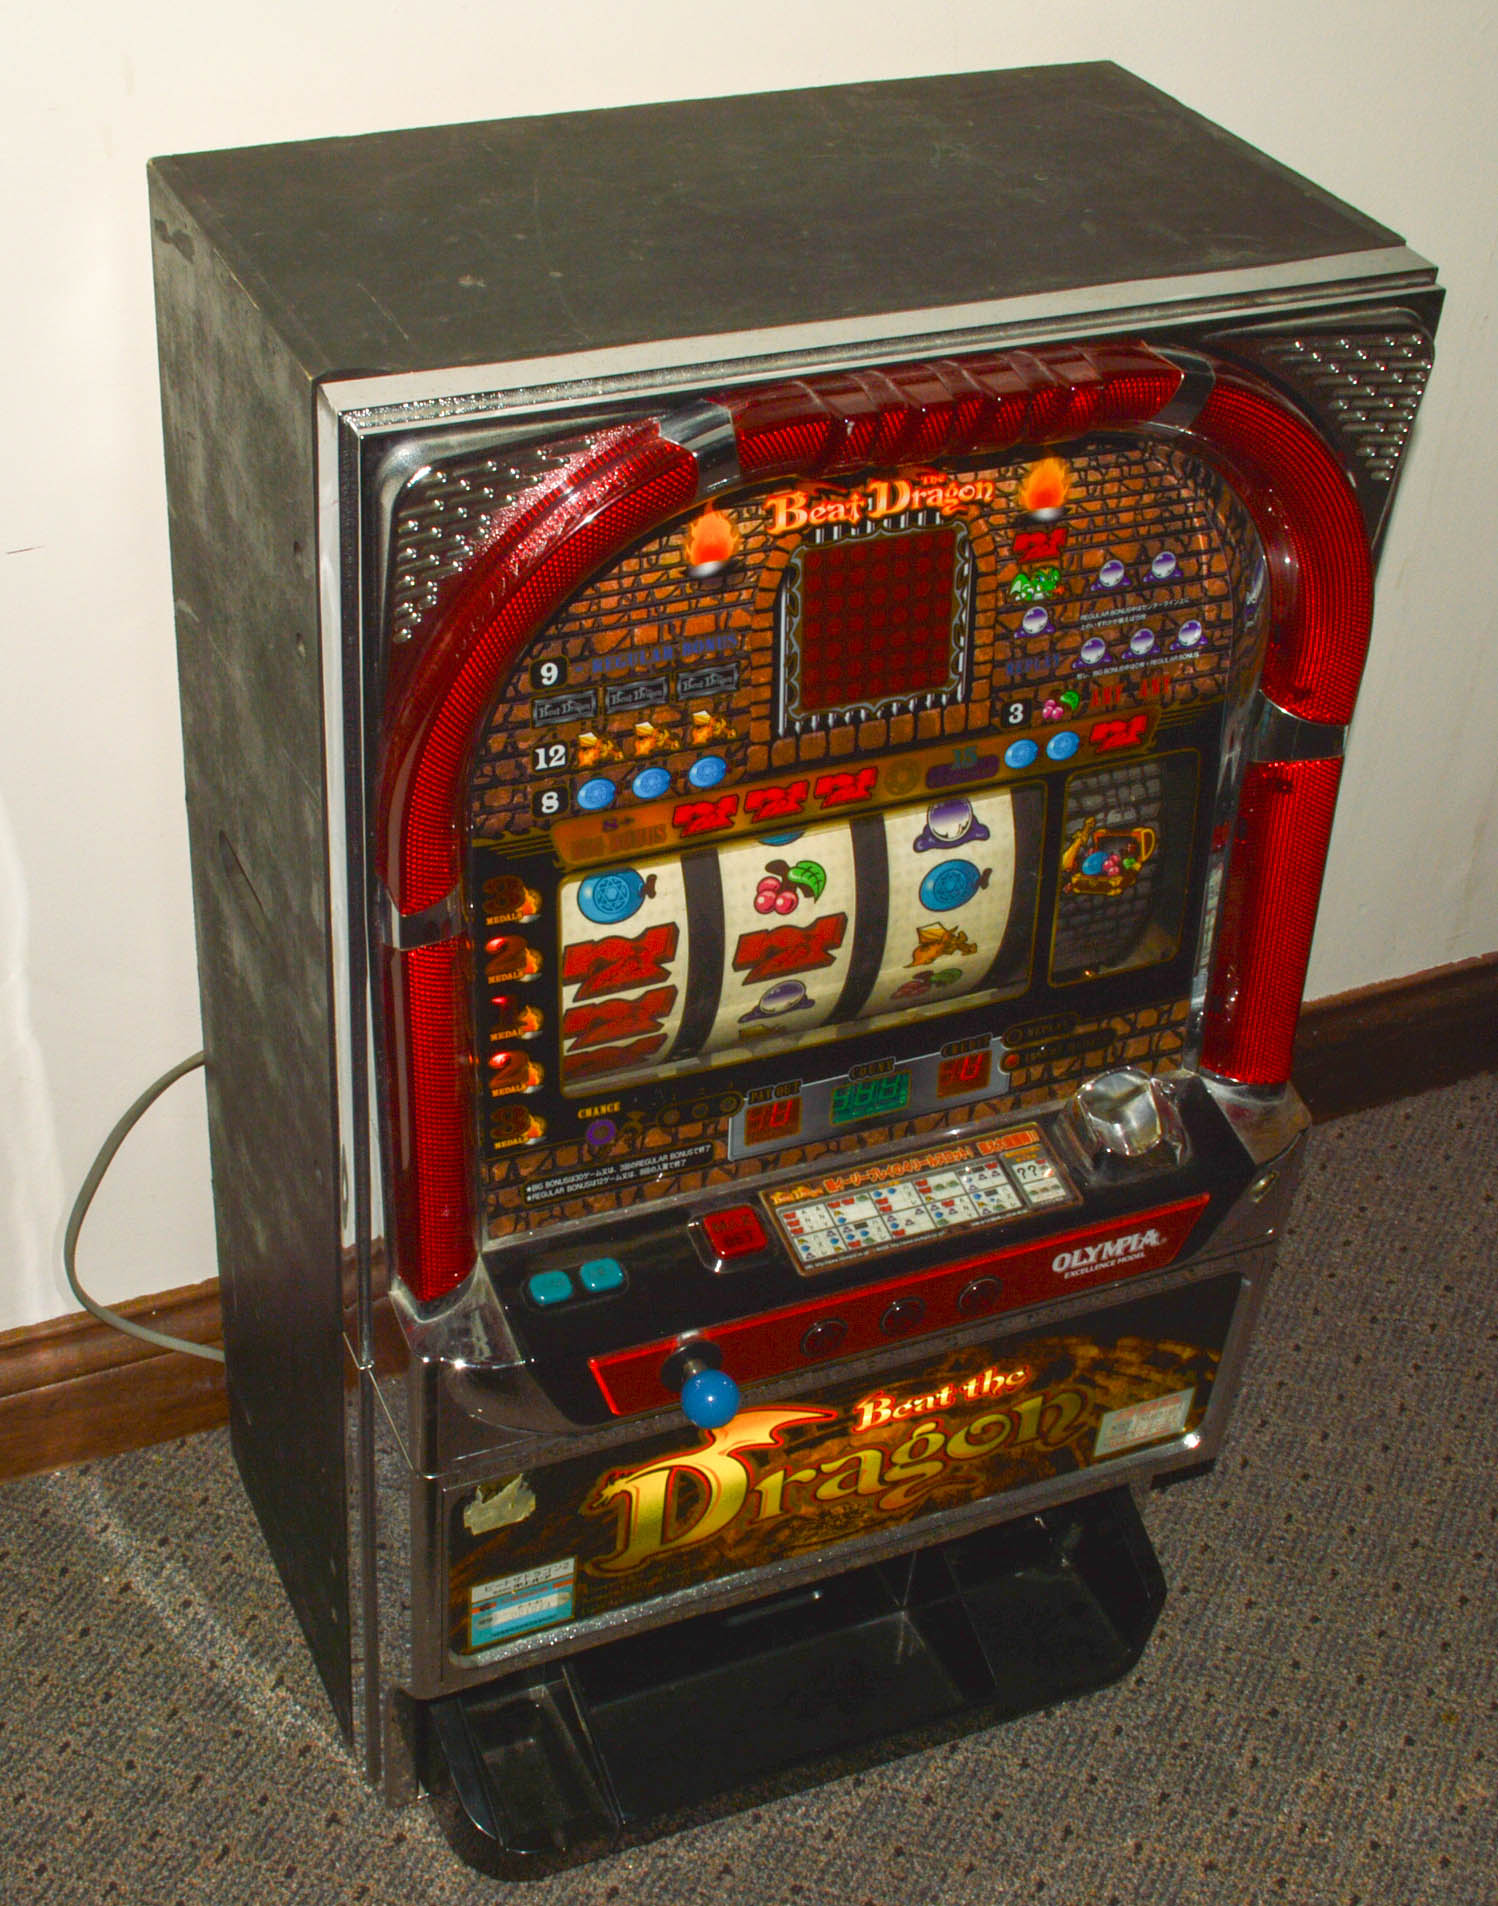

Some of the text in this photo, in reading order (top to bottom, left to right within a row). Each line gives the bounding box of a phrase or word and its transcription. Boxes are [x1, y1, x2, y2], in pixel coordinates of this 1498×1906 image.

[763, 478, 995, 535] Beat Dragon
[540, 662, 558, 686] 9
[1008, 702, 1024, 725] 3
[534, 744, 566, 771] 12
[541, 791, 559, 814] 8
[485, 935, 528, 975] 2
[488, 1051, 529, 1089] 2
[577, 1101, 621, 1119] CHANCE
[1052, 1228, 1161, 1273] OLYMPIA
[1064, 1251, 1146, 1279] EXCELLENCE MODEL
[854, 1367, 1029, 1431] Beat the
[591, 1390, 1090, 1572] Dragon
